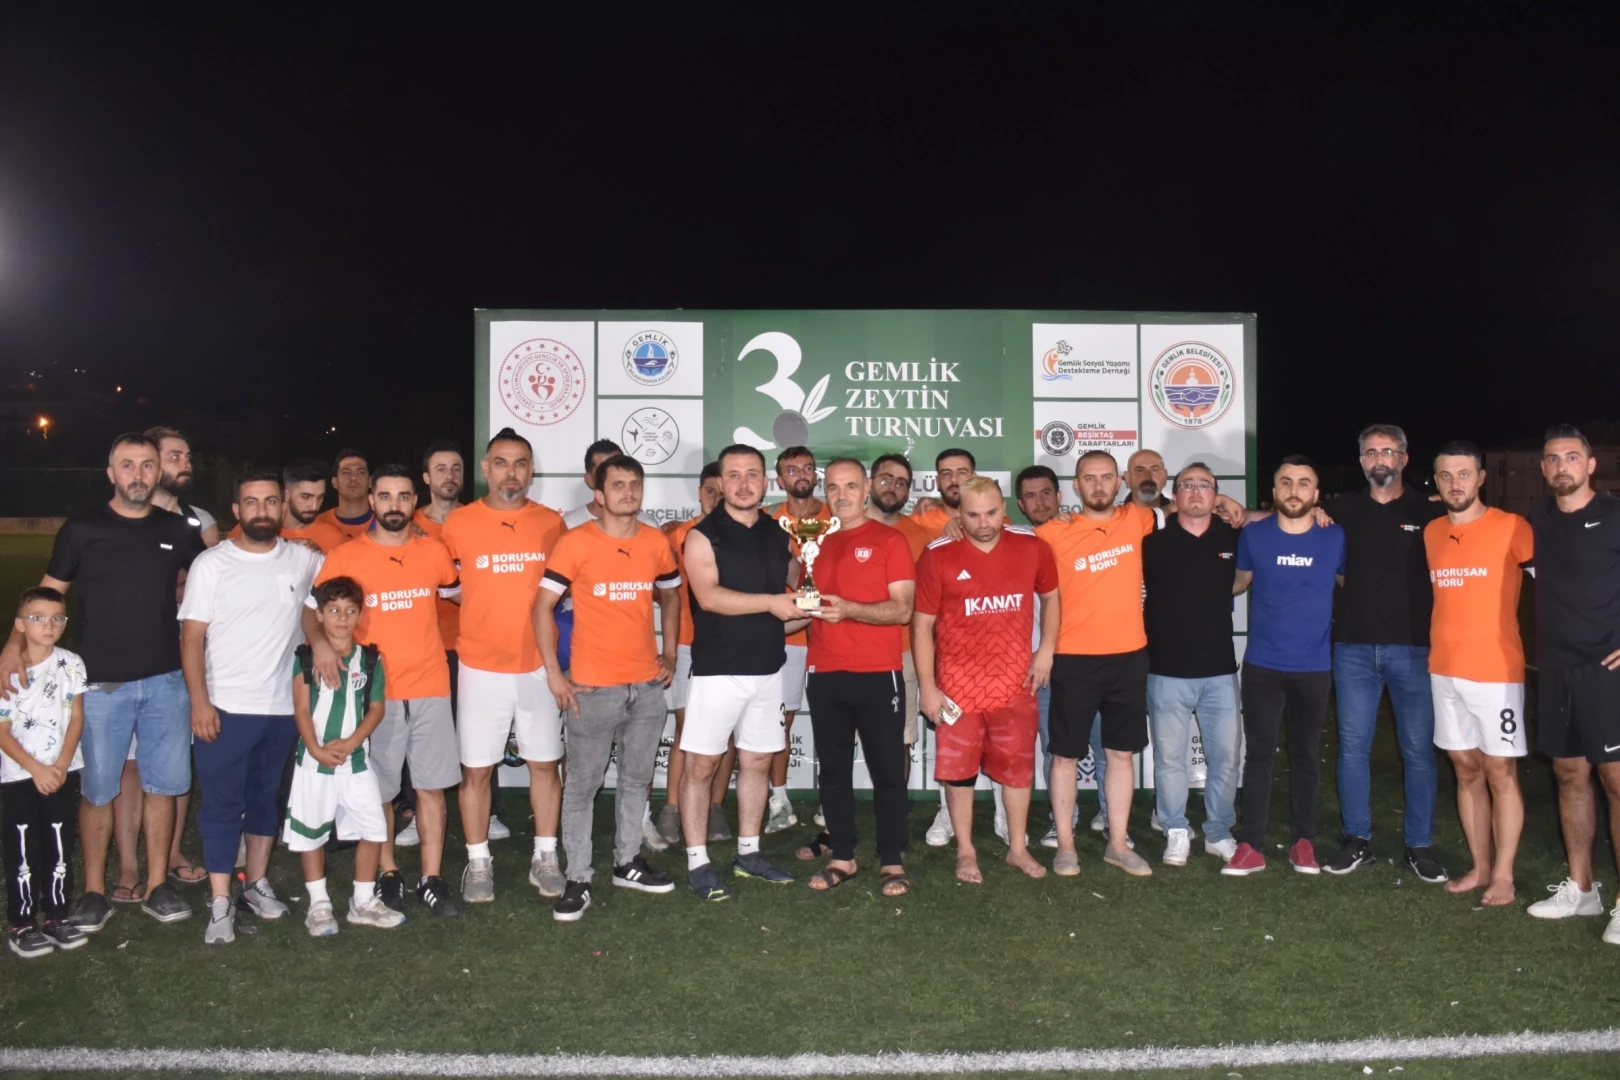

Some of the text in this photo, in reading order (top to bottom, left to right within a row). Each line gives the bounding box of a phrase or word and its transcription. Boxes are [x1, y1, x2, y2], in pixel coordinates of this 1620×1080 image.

[632, 334, 669, 346] GEMLİK
[1083, 360, 1105, 369] Sosyal
[1106, 360, 1131, 369] Yaşamı
[1161, 348, 1223, 369] GEMLİK BELEDİYESİ
[845, 357, 961, 382] GEMLİK
[1102, 367, 1131, 376] Derneği
[845, 384, 949, 410] ZEYTİN
[845, 416, 1004, 437] TURNUVASI
[1077, 422, 1106, 430] GEMLİK
[1077, 430, 1114, 439] BEŞİKTAŞ
[492, 552, 546, 564] BORUSAN
[1087, 543, 1134, 564] BORUSAN
[492, 563, 525, 574] BORU
[1090, 558, 1118, 573] BORU
[1436, 567, 1488, 578] BORUSAN
[1437, 578, 1464, 588] BORU
[380, 587, 432, 602] BORUSAN
[609, 591, 637, 601] BORU
[381, 599, 413, 612] BORU
[1500, 708, 1517, 734] 8
